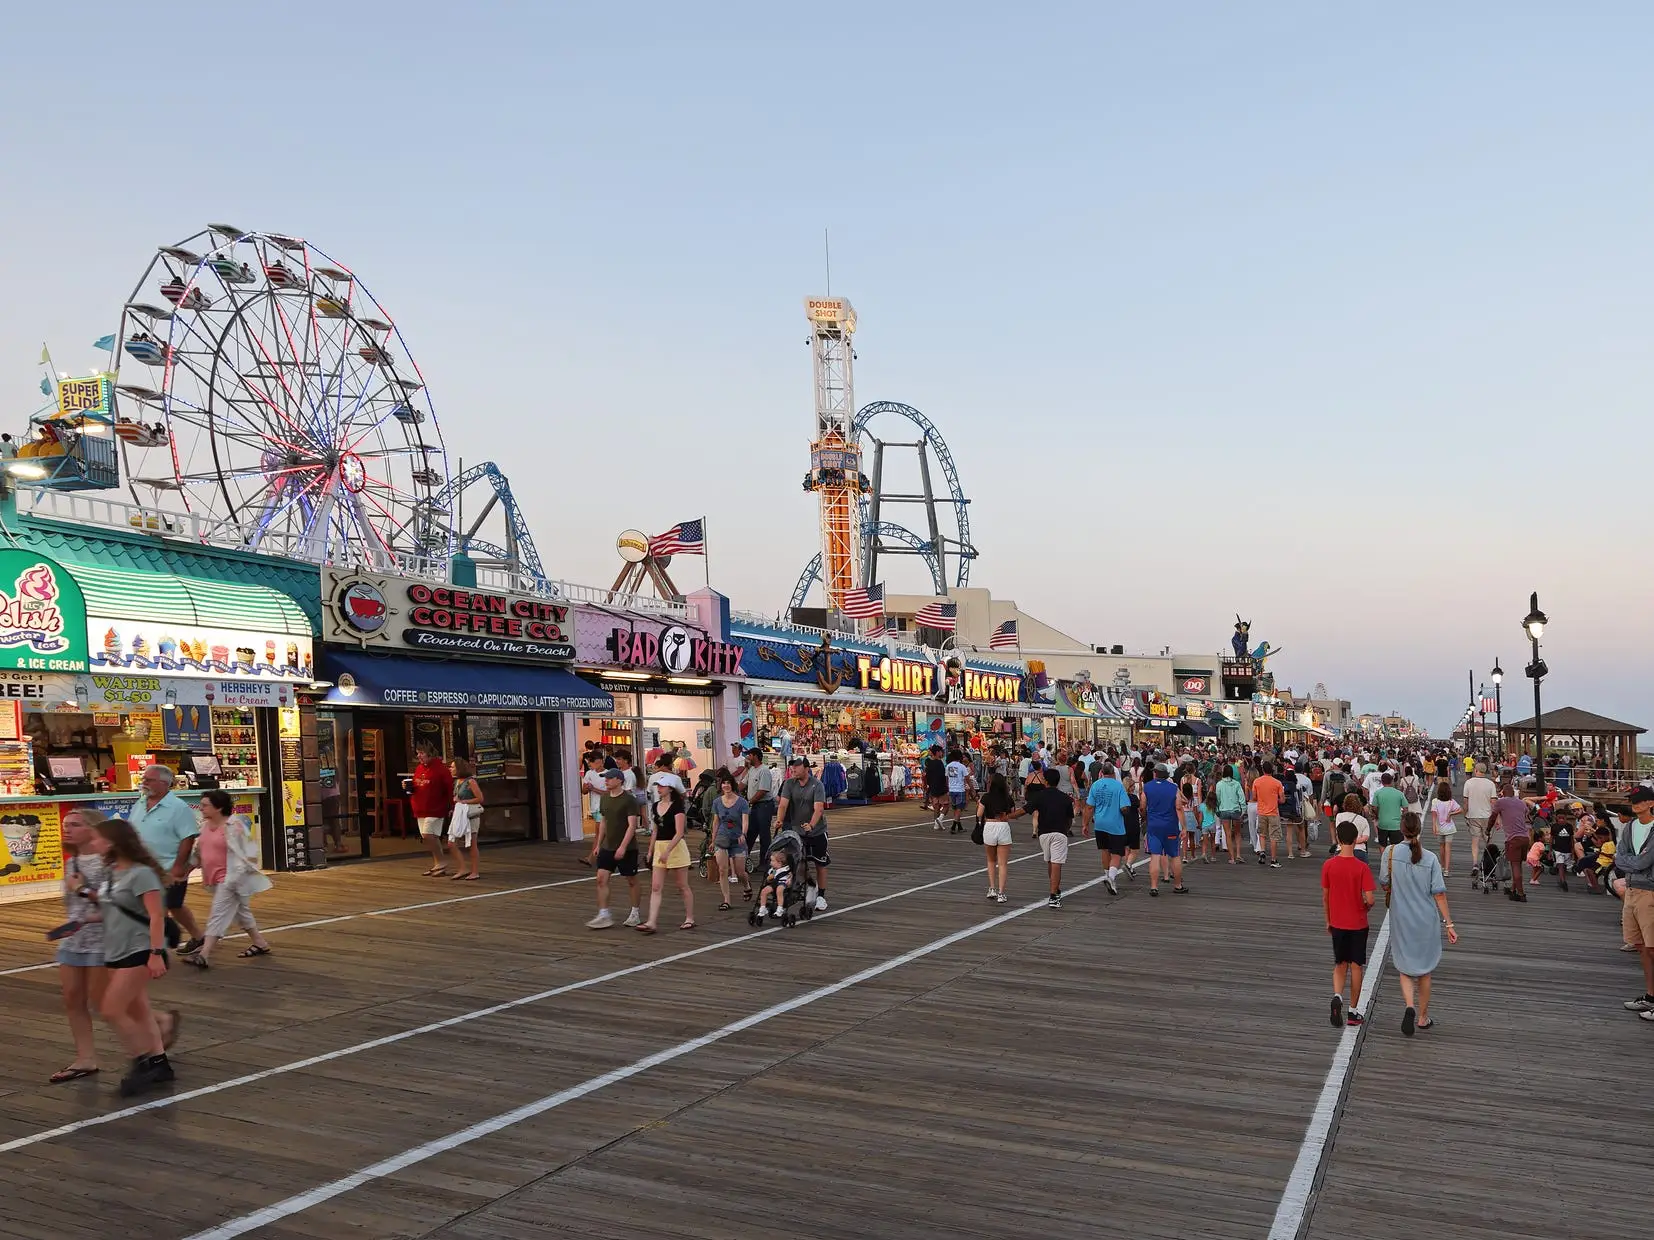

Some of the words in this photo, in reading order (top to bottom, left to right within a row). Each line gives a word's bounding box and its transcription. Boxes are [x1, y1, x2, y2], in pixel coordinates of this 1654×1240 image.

[809, 301, 842, 309] DOUBLE
[815, 310, 837, 318] SHOT
[62, 383, 99, 397] SUPER
[63, 396, 100, 409] SLIDE
[409, 585, 506, 614] OCEAN
[513, 600, 568, 622] CITY
[410, 607, 522, 637] COFFEE
[527, 622, 569, 642] CO.
[418, 632, 481, 649] Roasted
[484, 640, 500, 650] On
[502, 642, 523, 652] The
[526, 644, 570, 656] Beach!
[615, 628, 659, 665] BAD
[695, 636, 744, 674] Kitty
[17, 658, 26, 668] &
[28, 658, 46, 669] ICE
[48, 660, 84, 670] CREAM
[92, 676, 162, 691] WATER
[858, 656, 934, 695] T-SHIRT
[964, 669, 1022, 703] FACTORY
[1188, 680, 1202, 690] DQ
[221, 682, 271, 694] HERSHEY'S
[600, 682, 614, 691] BAD
[104, 688, 152, 703] $1.50
[224, 694, 238, 703] Ice
[240, 695, 269, 704] Cream
[384, 688, 418, 702] COFFEE
[428, 691, 468, 704] ESPRESSO
[478, 693, 528, 706] CAPPUCCINOS
[536, 696, 560, 707] LATTES
[566, 697, 590, 708] FROZEN
[590, 698, 612, 708] DRINKS
[8, 872, 55, 882] CHILLERS
